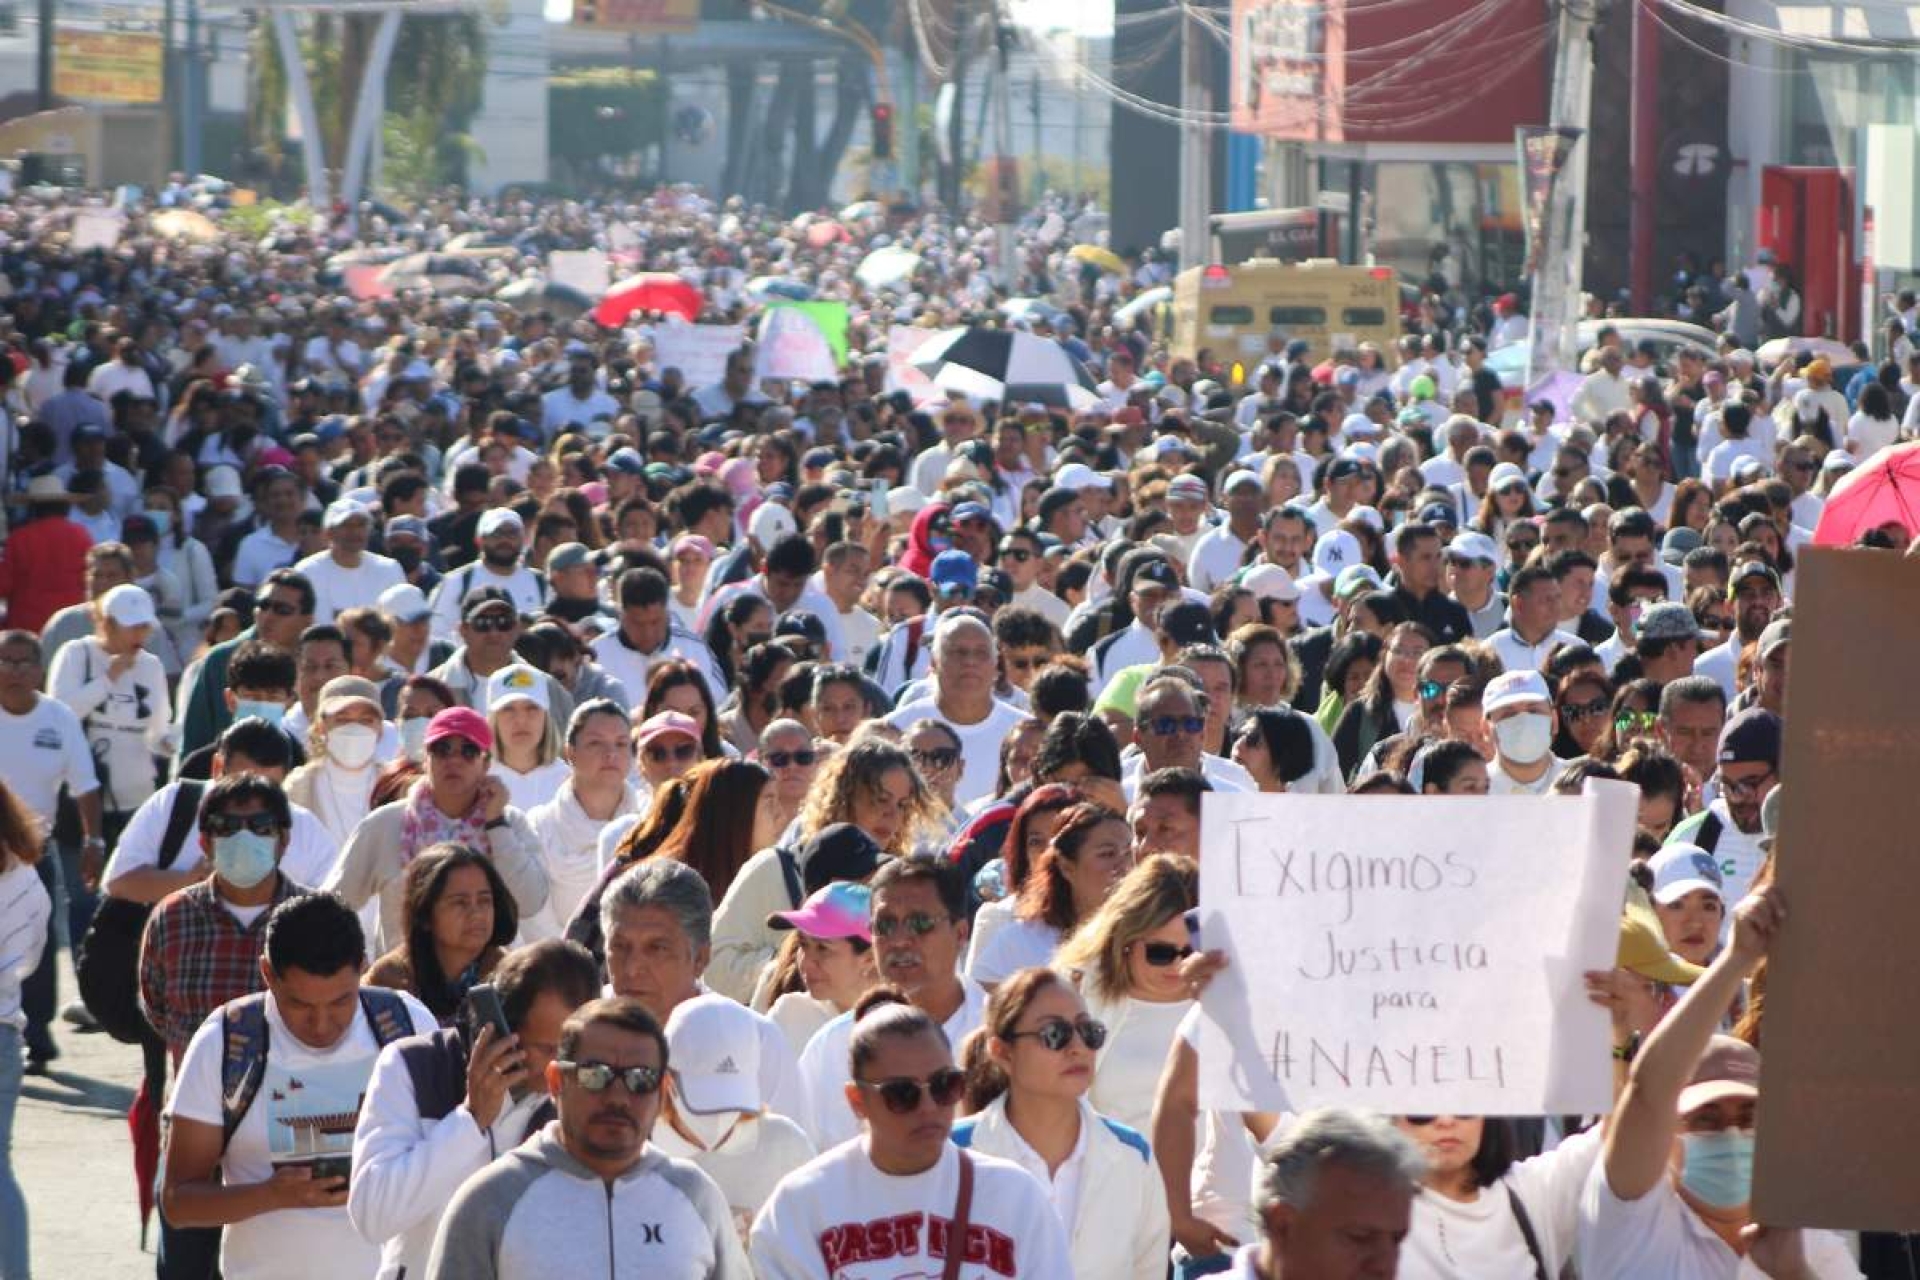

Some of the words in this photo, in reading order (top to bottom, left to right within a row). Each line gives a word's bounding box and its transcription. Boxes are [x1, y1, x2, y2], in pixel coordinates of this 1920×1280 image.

[1229, 816, 1477, 924] Exigimos
[1298, 930, 1488, 980] Justicia
[1372, 991, 1438, 1019] para
[1264, 1030, 1505, 1088] #NAYELI
[819, 1210, 924, 1276] EAST
